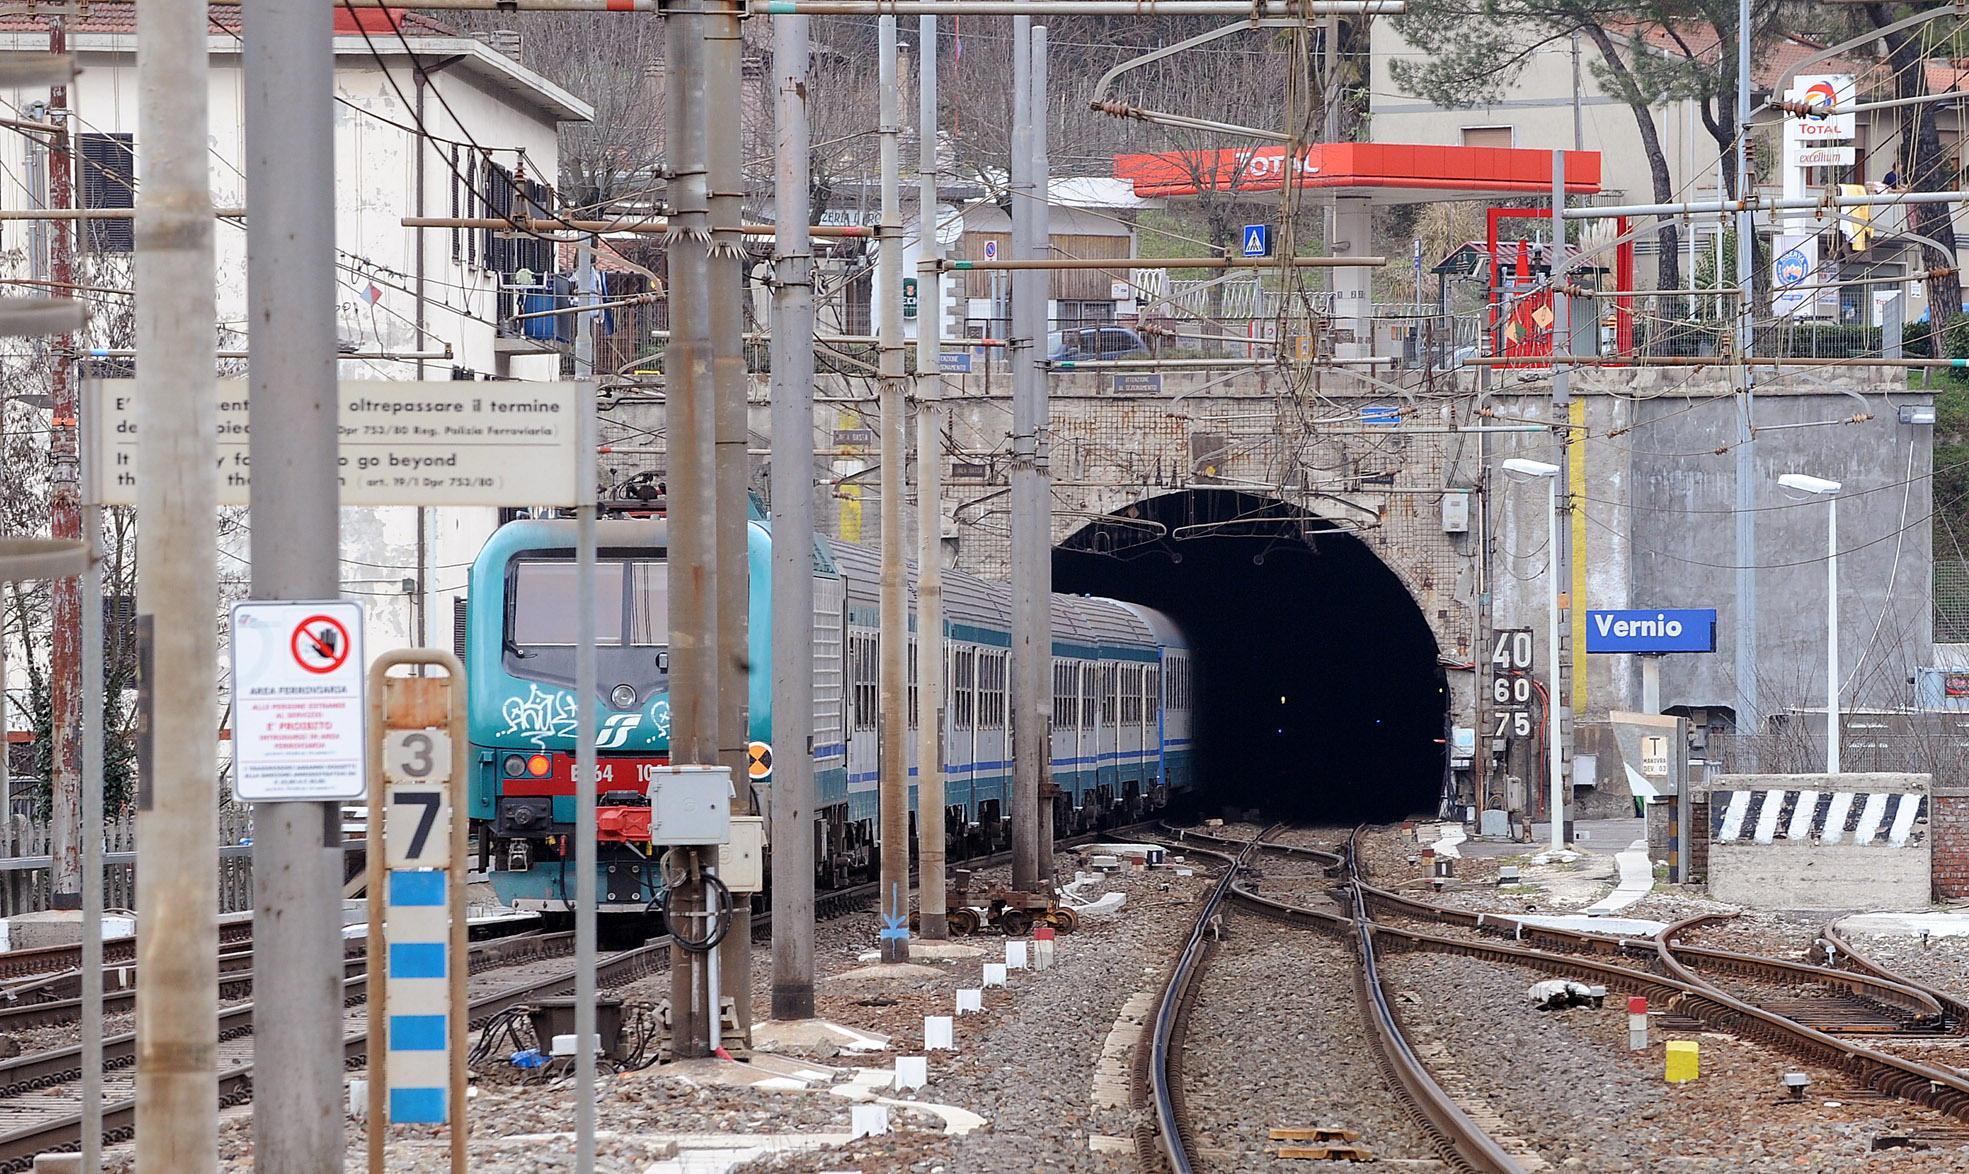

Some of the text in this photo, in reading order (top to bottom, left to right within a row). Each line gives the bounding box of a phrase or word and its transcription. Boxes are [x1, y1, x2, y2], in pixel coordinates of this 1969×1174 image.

[1799, 124, 1842, 134] TOTAL
[1800, 150, 1841, 163] excellium
[822, 212, 850, 224] ZERIA
[349, 399, 464, 415] oltrepassare
[472, 399, 482, 412] il
[490, 400, 560, 413] termine
[116, 421, 138, 434] de
[413, 426, 440, 437] Reg.
[444, 425, 482, 436] Polizia
[117, 453, 129, 465] It
[358, 456, 380, 470] go
[389, 454, 456, 470] beyond
[118, 473, 136, 486] th
[423, 478, 443, 489] Dpr
[1594, 614, 1682, 637] Vernio
[1492, 632, 1532, 669] 40
[250, 686, 347, 695] AREA FERROVIARIA
[1494, 678, 1530, 702] 60
[279, 722, 333, 730] PROIBITO
[1494, 711, 1531, 737] 75
[402, 733, 434, 778] 3
[1649, 738, 1661, 756] T
[571, 764, 662, 782] E64 10
[394, 792, 441, 859] 7
